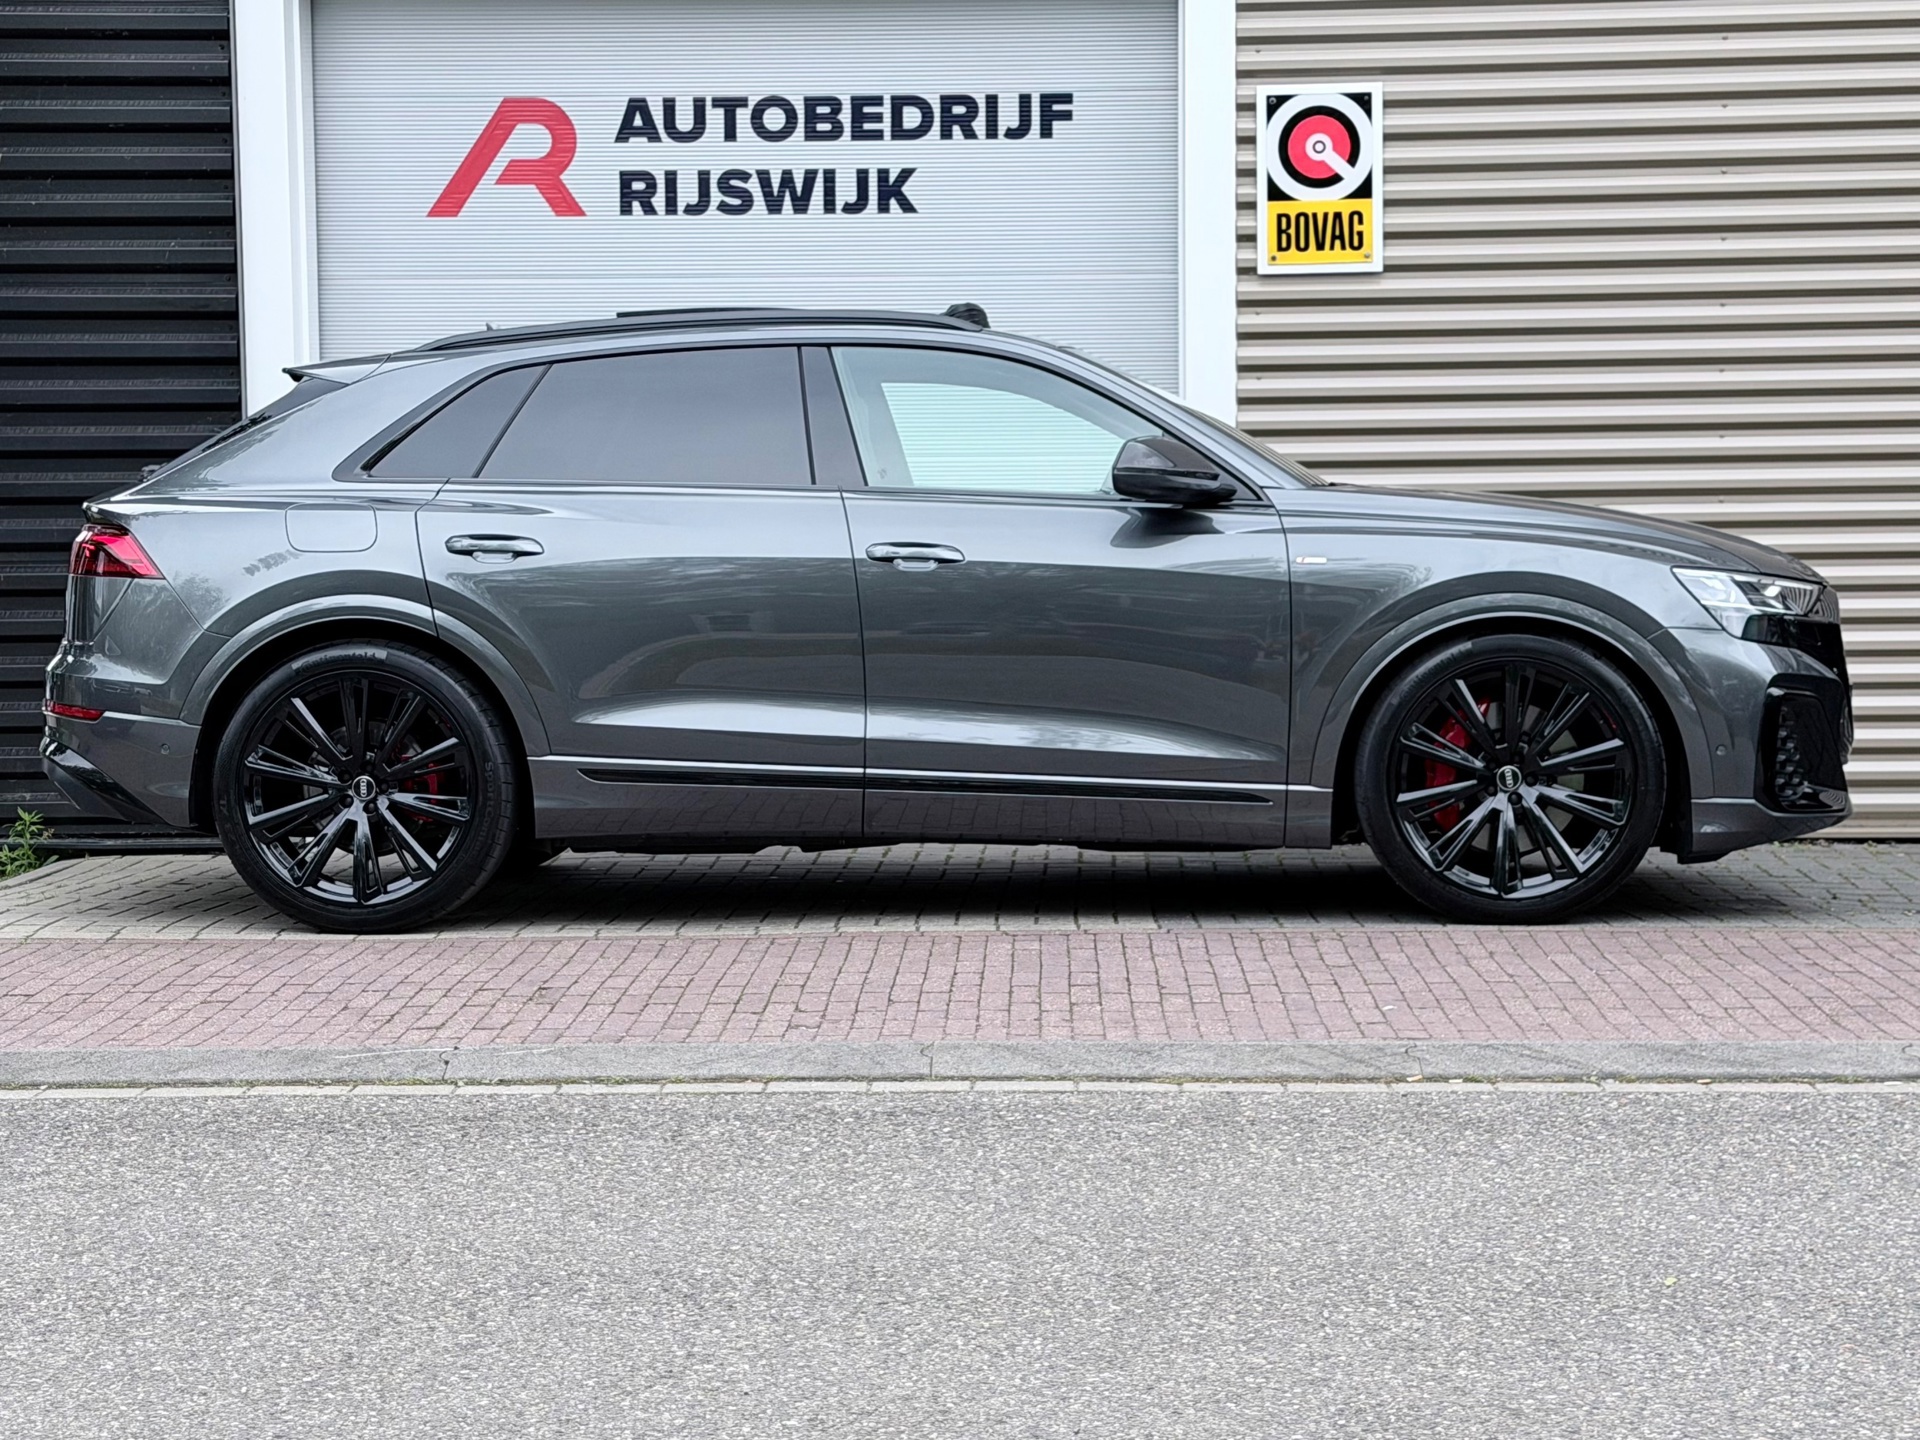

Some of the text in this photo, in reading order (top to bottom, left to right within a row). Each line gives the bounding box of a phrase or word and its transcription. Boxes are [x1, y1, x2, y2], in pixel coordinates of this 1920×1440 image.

[614, 94, 1075, 143] AUTOBEDRIJF
[620, 168, 917, 215] RIJSWIJK
[1277, 211, 1363, 252] BOVAG
